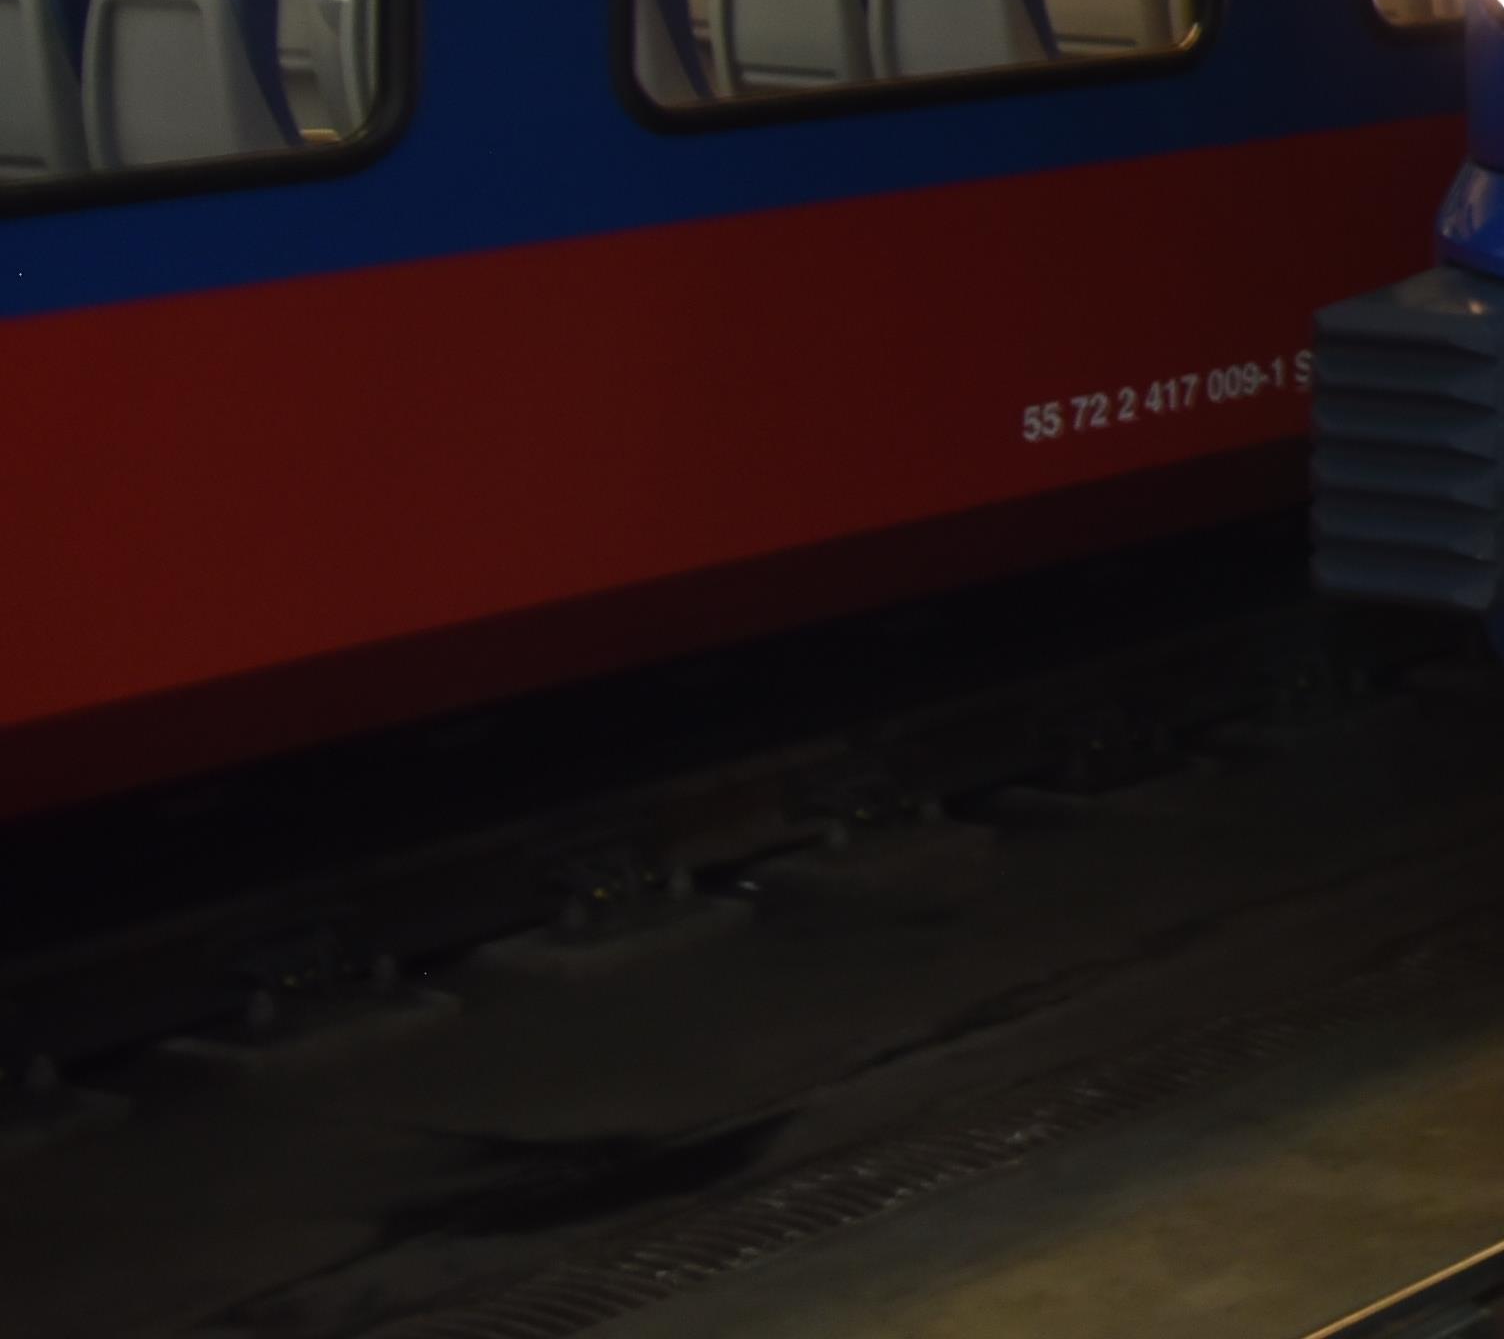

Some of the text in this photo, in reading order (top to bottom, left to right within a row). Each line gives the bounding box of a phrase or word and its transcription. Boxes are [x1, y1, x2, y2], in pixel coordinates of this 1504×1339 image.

[1022, 400, 1063, 442] 55
[1070, 392, 1109, 431] 72
[1117, 386, 1138, 421] 2
[1144, 372, 1200, 413] 417
[1206, 356, 1285, 403] 009-1
